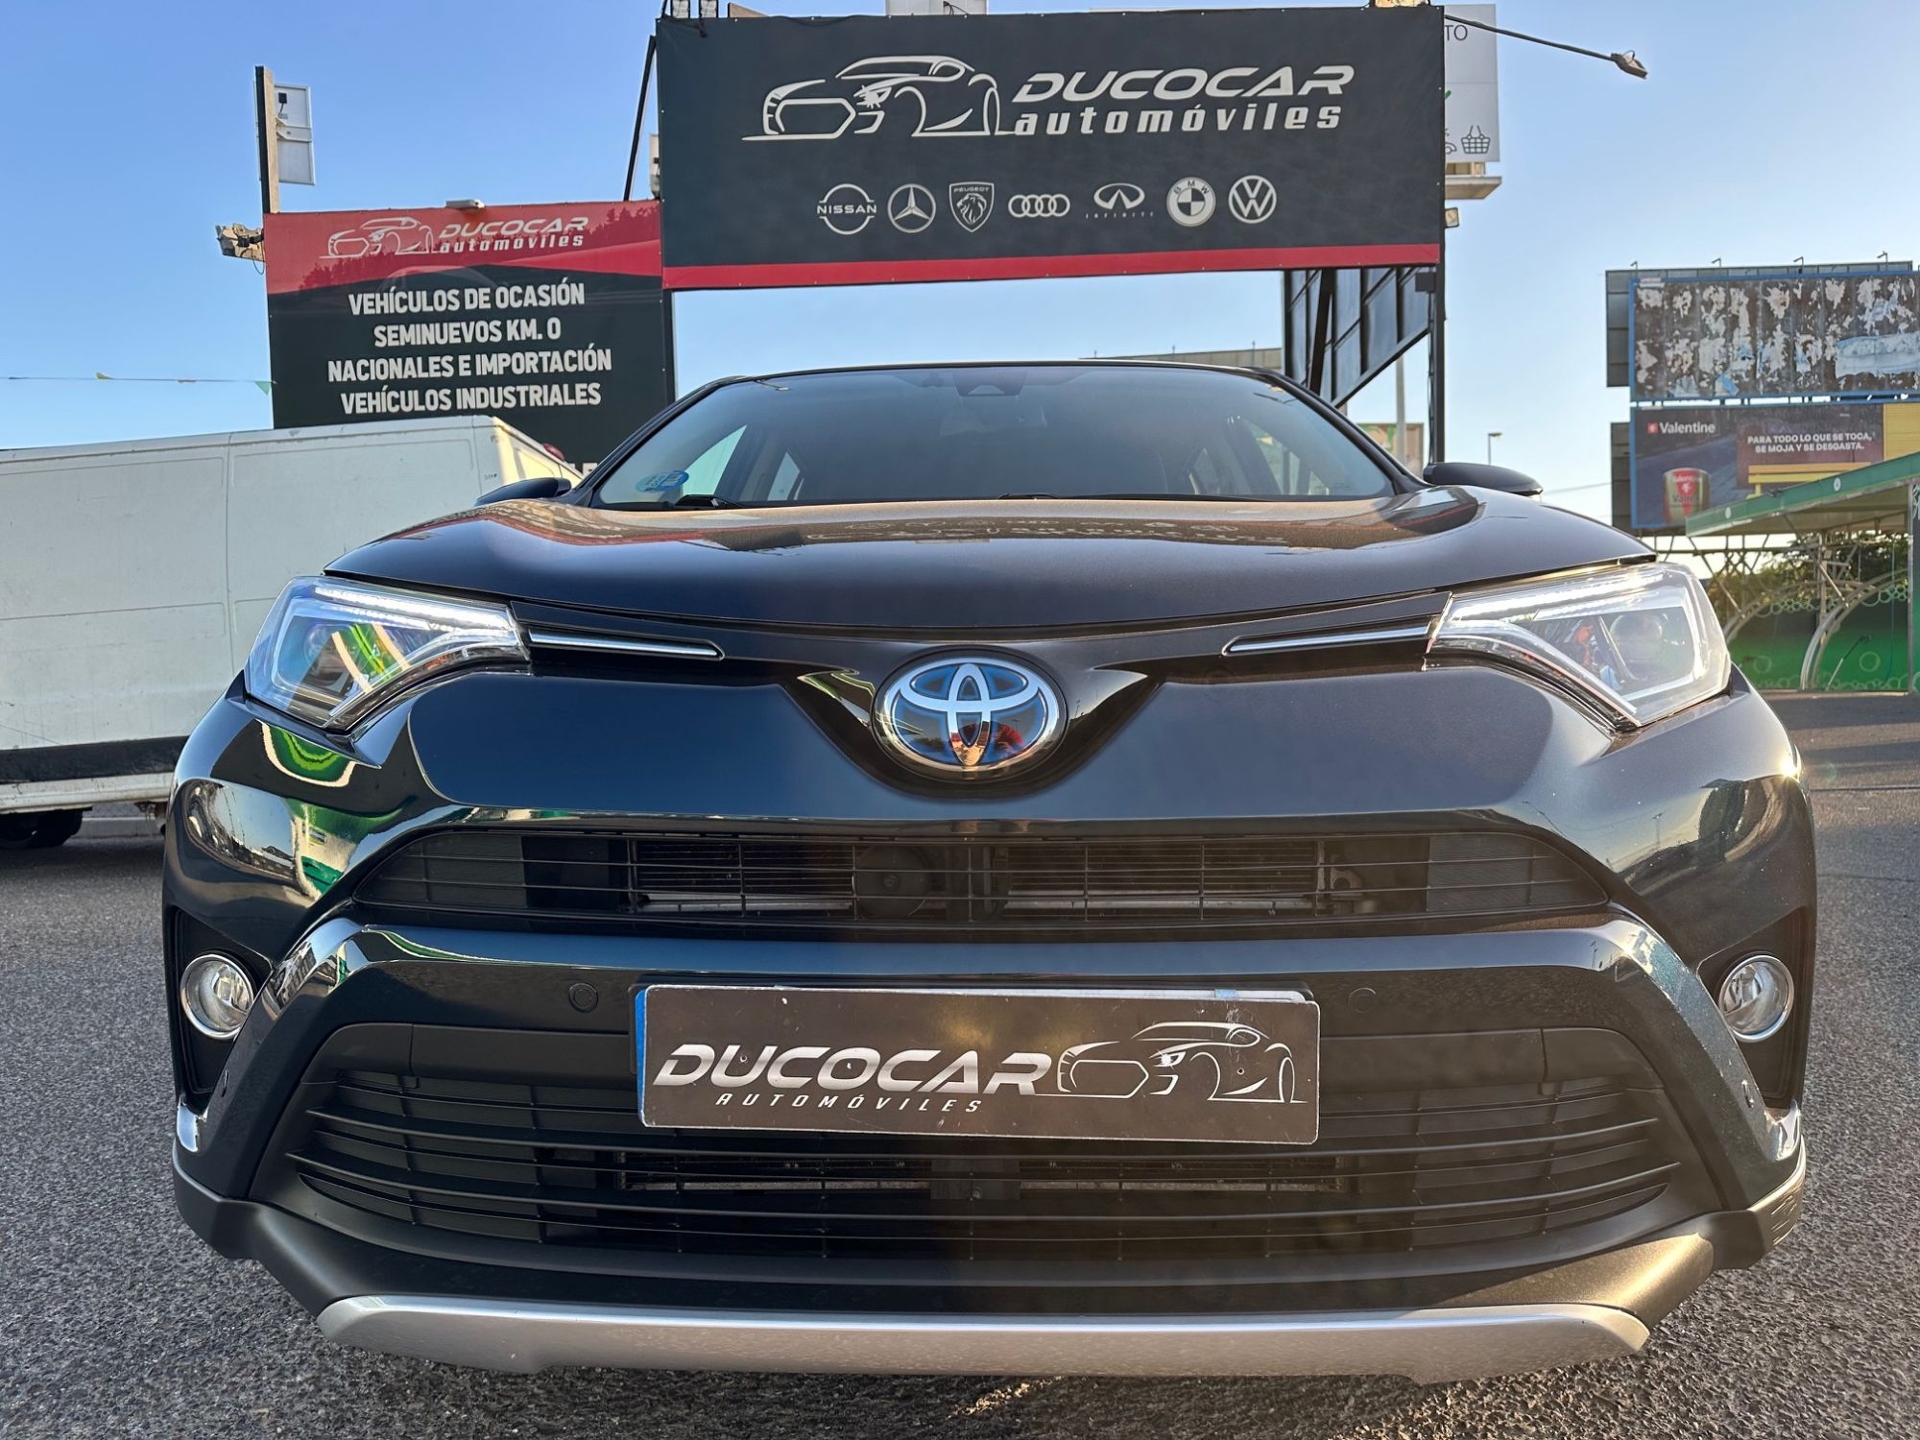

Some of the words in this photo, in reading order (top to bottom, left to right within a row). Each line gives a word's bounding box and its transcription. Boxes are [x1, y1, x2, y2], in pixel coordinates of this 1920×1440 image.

[1012, 65, 1354, 102] DUCOCAR
[1014, 103, 1341, 136] automóviles
[816, 204, 877, 214] NISSAN
[439, 216, 589, 239] DUCOCAR
[348, 286, 460, 315] VEHÍCULOS
[464, 288, 491, 309] DE
[495, 277, 585, 308] OCASIÓN
[374, 320, 501, 347] SEMINUEVOS
[506, 318, 543, 341] KM.
[327, 355, 453, 382] NACIONALES
[459, 355, 471, 376] E
[475, 343, 612, 376] IMPORTACIÓN
[340, 385, 451, 414] VEHÍCULOS
[456, 383, 601, 410] INDUSTRIALES
[1659, 422, 1716, 434] Valentine
[1747, 436, 1772, 445] PARA
[1773, 435, 1798, 443] TODO
[1799, 434, 1811, 442] LO
[1812, 433, 1831, 442] QUE
[1832, 433, 1843, 441] SE
[1845, 432, 1872, 441] TOCA,
[1755, 445, 1766, 453] SE
[1768, 444, 1794, 453] MOJA
[1804, 443, 1814, 451] SE
[652, 1043, 1052, 1095] DUCOCAR
[715, 1093, 982, 1113] AUTOMÓVILES
